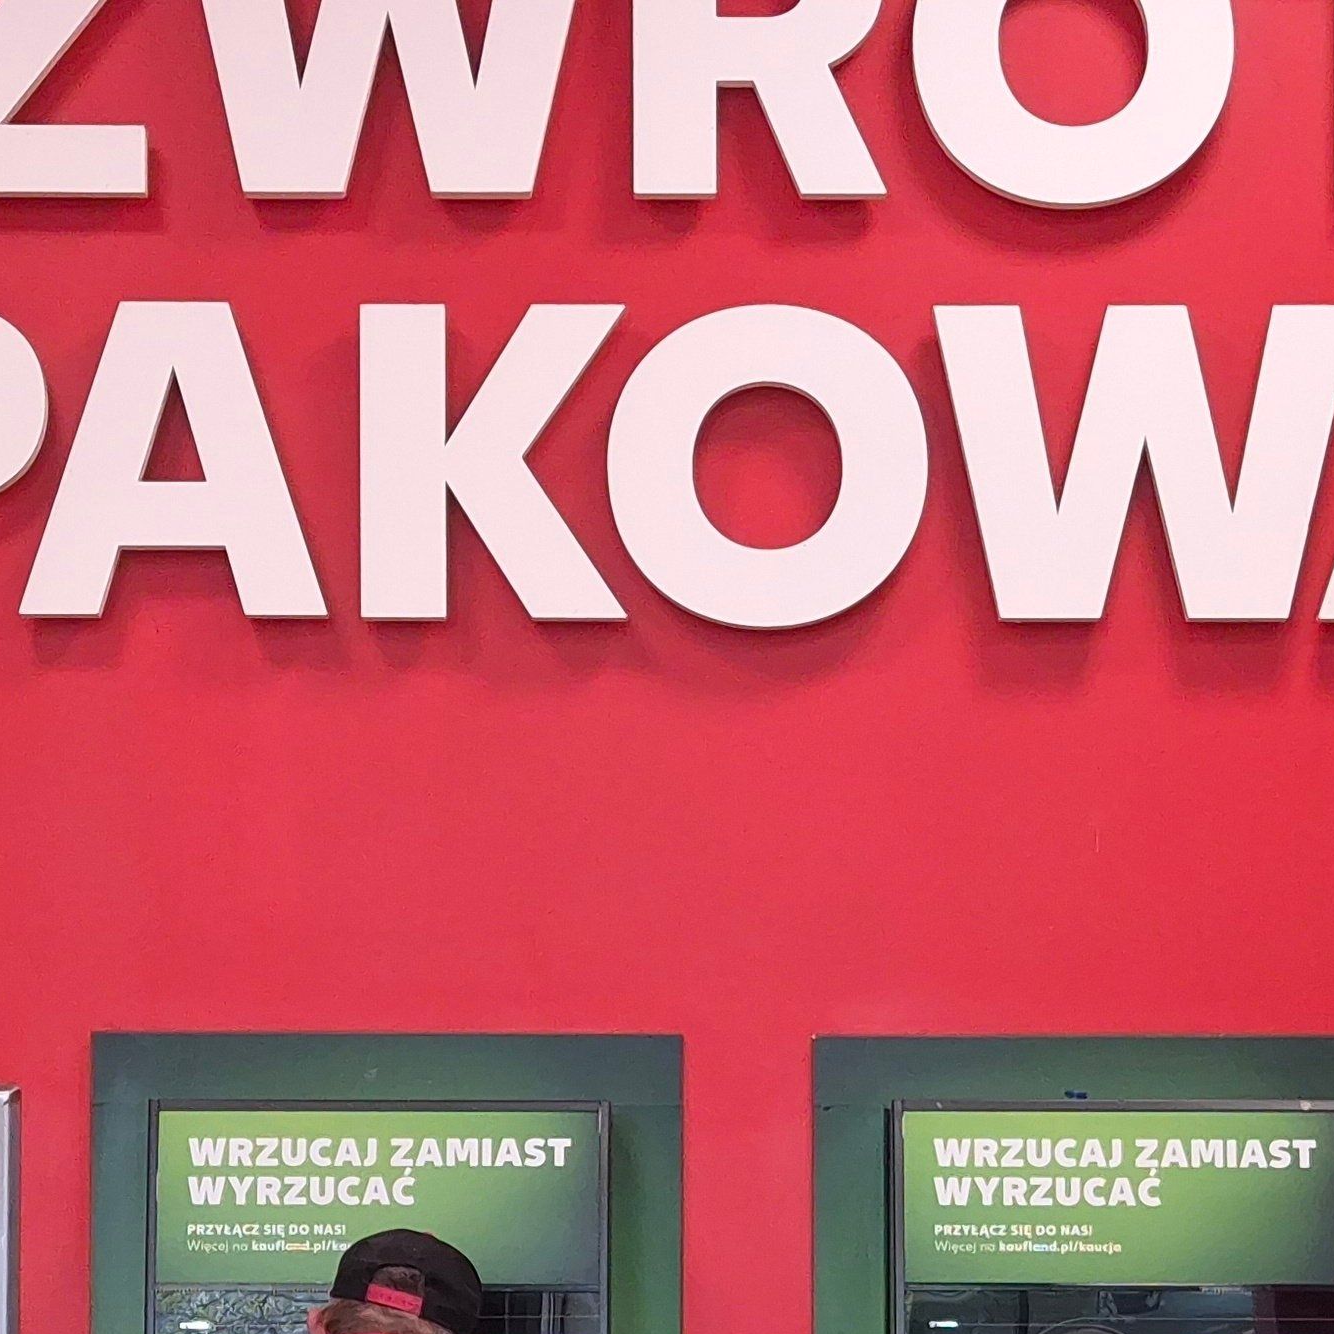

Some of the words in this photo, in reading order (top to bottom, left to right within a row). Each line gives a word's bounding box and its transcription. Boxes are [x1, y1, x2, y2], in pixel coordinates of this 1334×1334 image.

[187, 1137, 377, 1166] WRZUCAJ
[391, 1138, 571, 1167] ZAMIAST
[933, 1138, 1122, 1168] WRZUCAJ
[1135, 1139, 1316, 1168] ZAMIAST
[187, 1168, 415, 1205] WYRZUCAĆ
[933, 1168, 1161, 1206] WYRZUCAĆ
[187, 1224, 259, 1237] PRZYŁĄCZ
[264, 1224, 285, 1237] SIĘ
[289, 1224, 309, 1235] DO
[313, 1224, 346, 1235] NAS!
[934, 1225, 1006, 1239] PRZYŁĄCZ
[1011, 1225, 1032, 1238] SIĘ
[1036, 1225, 1056, 1236] DO
[1060, 1225, 1092, 1236] NAS!
[187, 1239, 228, 1252] Więcej
[232, 1243, 248, 1251] na
[934, 1240, 977, 1253] Więcej
[980, 1243, 995, 1252] na
